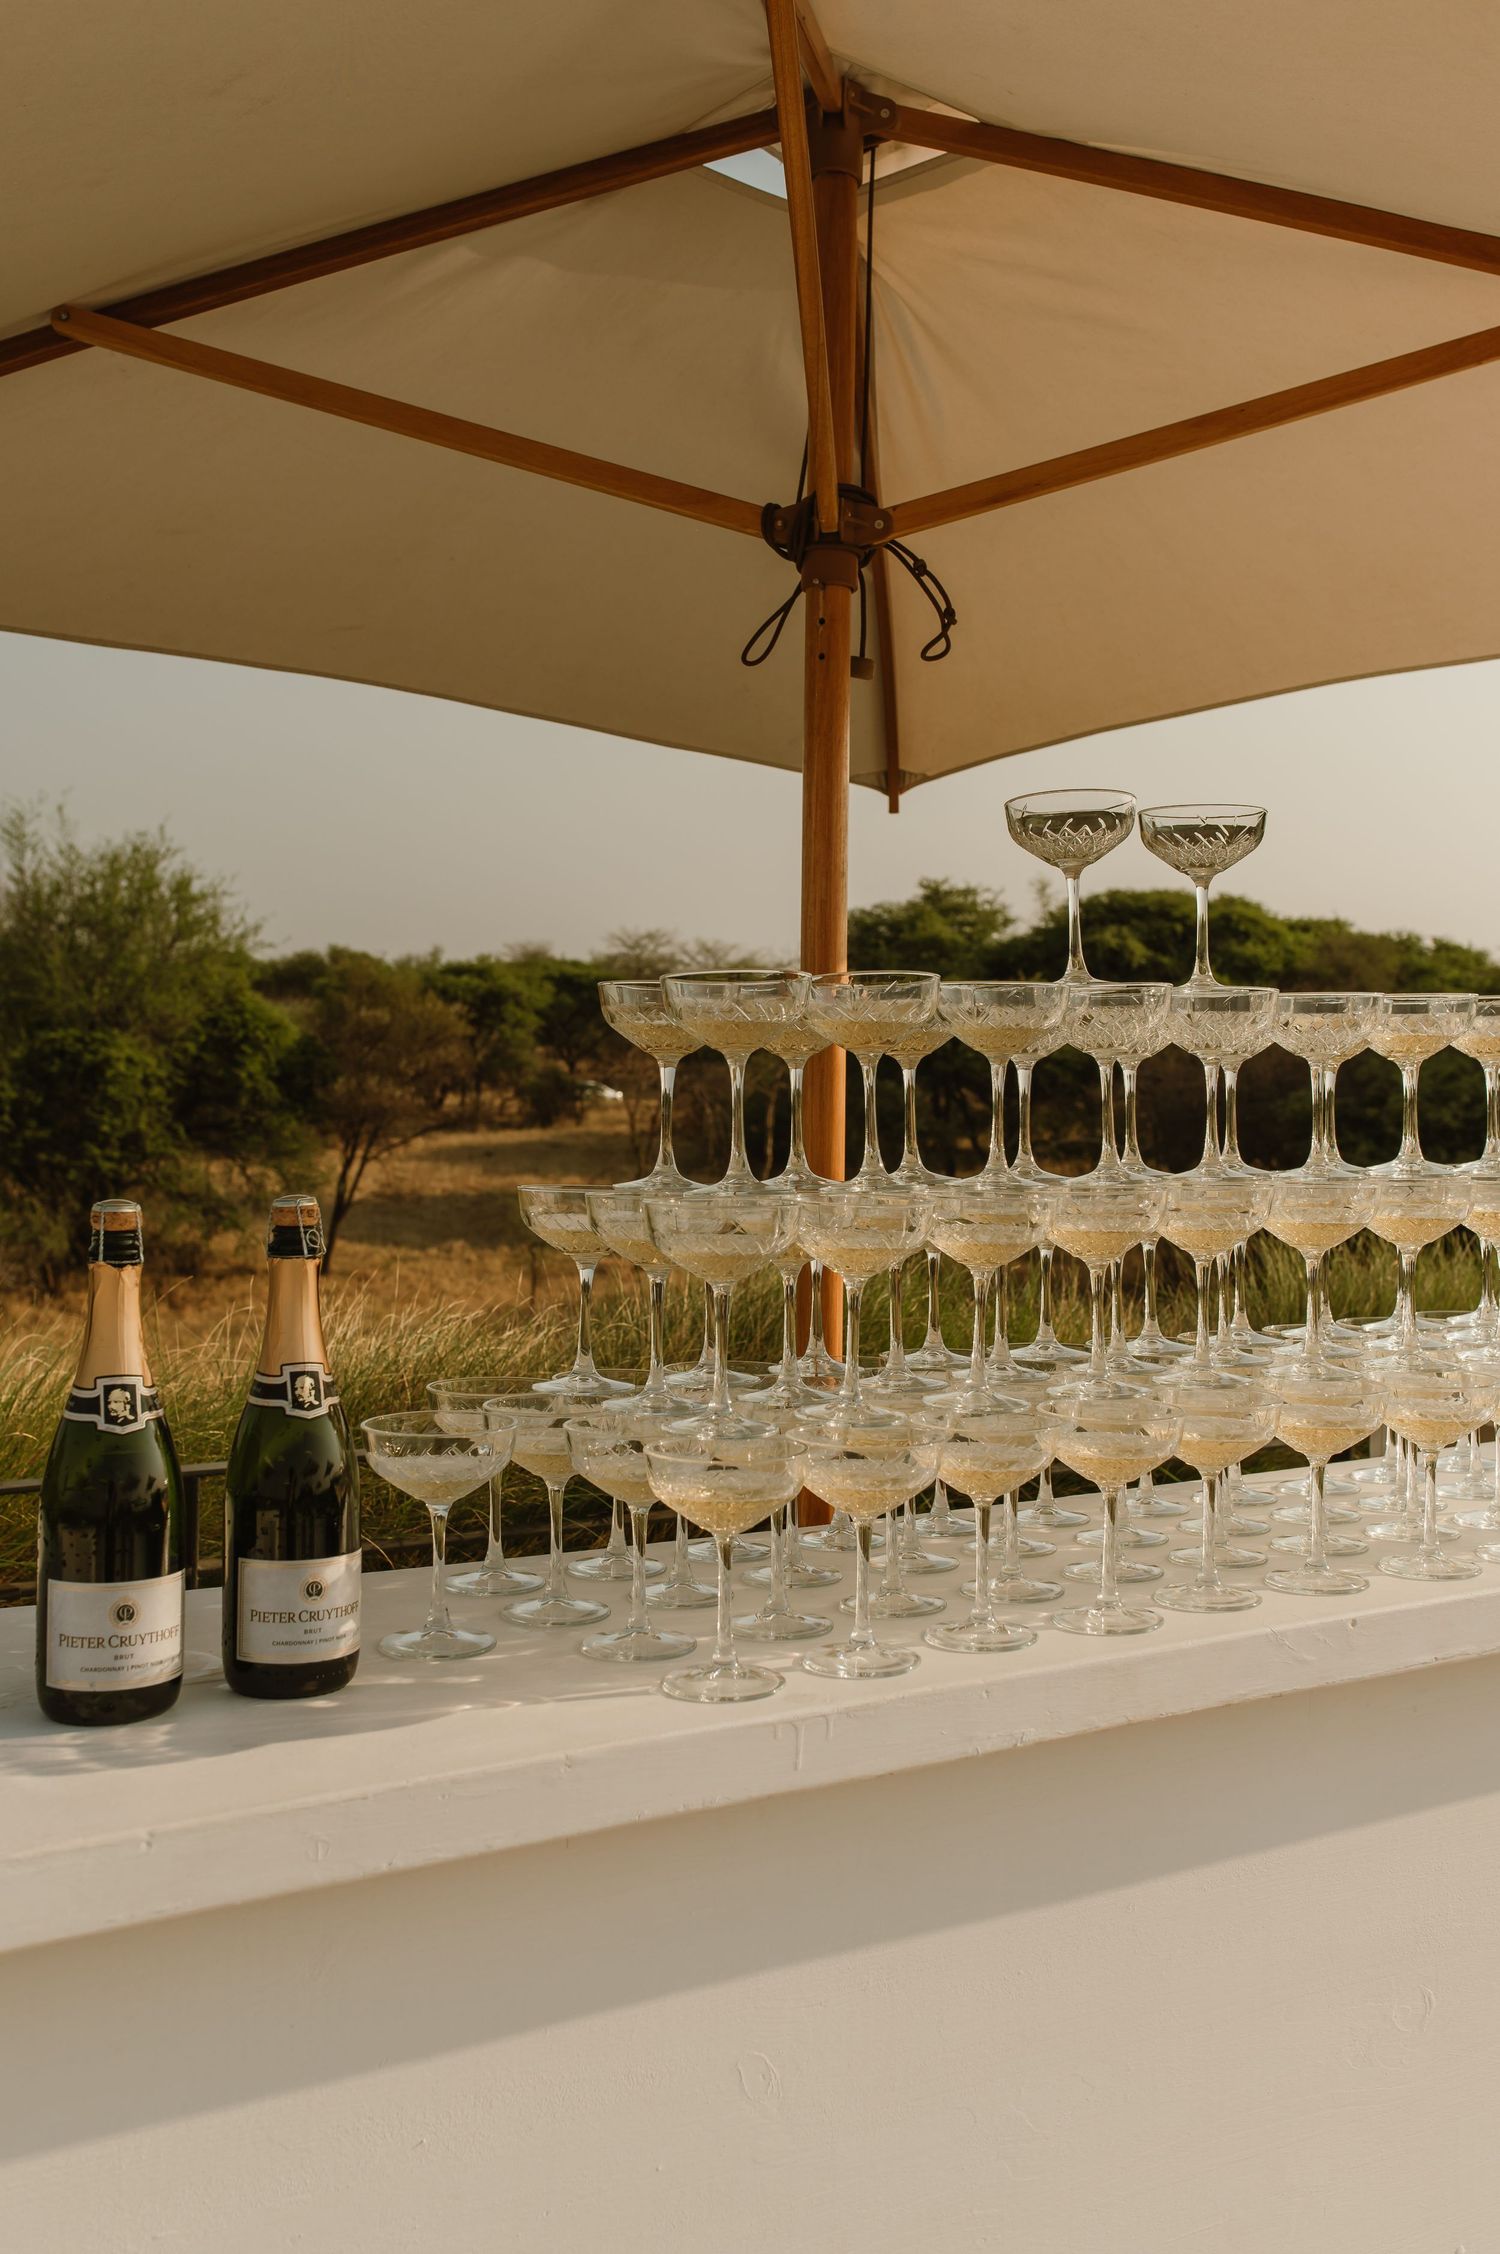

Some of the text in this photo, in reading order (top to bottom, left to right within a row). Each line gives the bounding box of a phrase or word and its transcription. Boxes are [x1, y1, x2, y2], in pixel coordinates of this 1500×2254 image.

[250, 1600, 360, 1624] PIETER CRUYTHOFF
[58, 1624, 180, 1649] PIETER CRUYTHOFF
[303, 1627, 322, 1635] BRUT
[113, 1653, 135, 1661] BRUT
